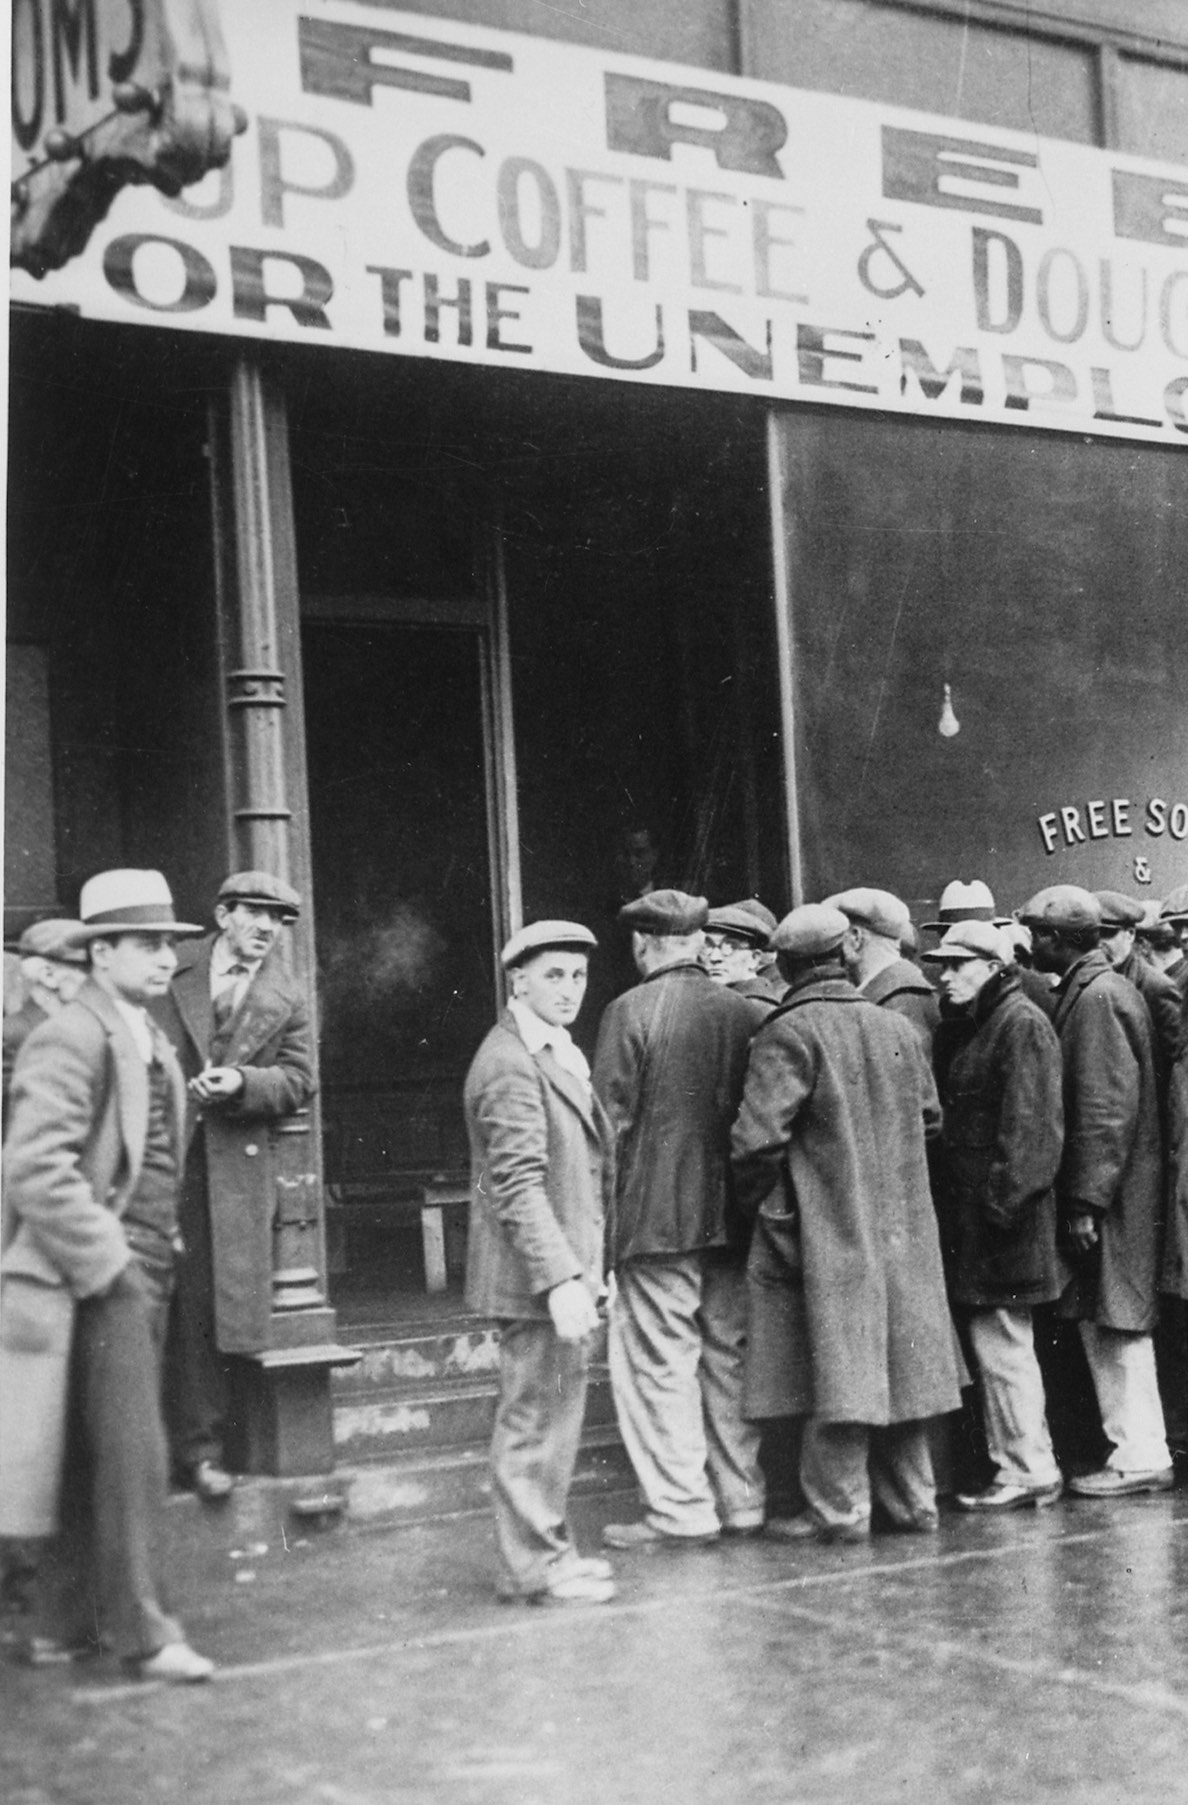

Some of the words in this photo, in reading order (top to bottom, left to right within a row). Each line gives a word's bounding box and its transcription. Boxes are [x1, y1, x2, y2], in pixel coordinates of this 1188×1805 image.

[406, 132, 808, 305] COFFEE
[857, 217, 927, 300] &
[365, 265, 533, 354] THE
[1038, 799, 1133, 854] FREE
[1134, 856, 1152, 884] &
